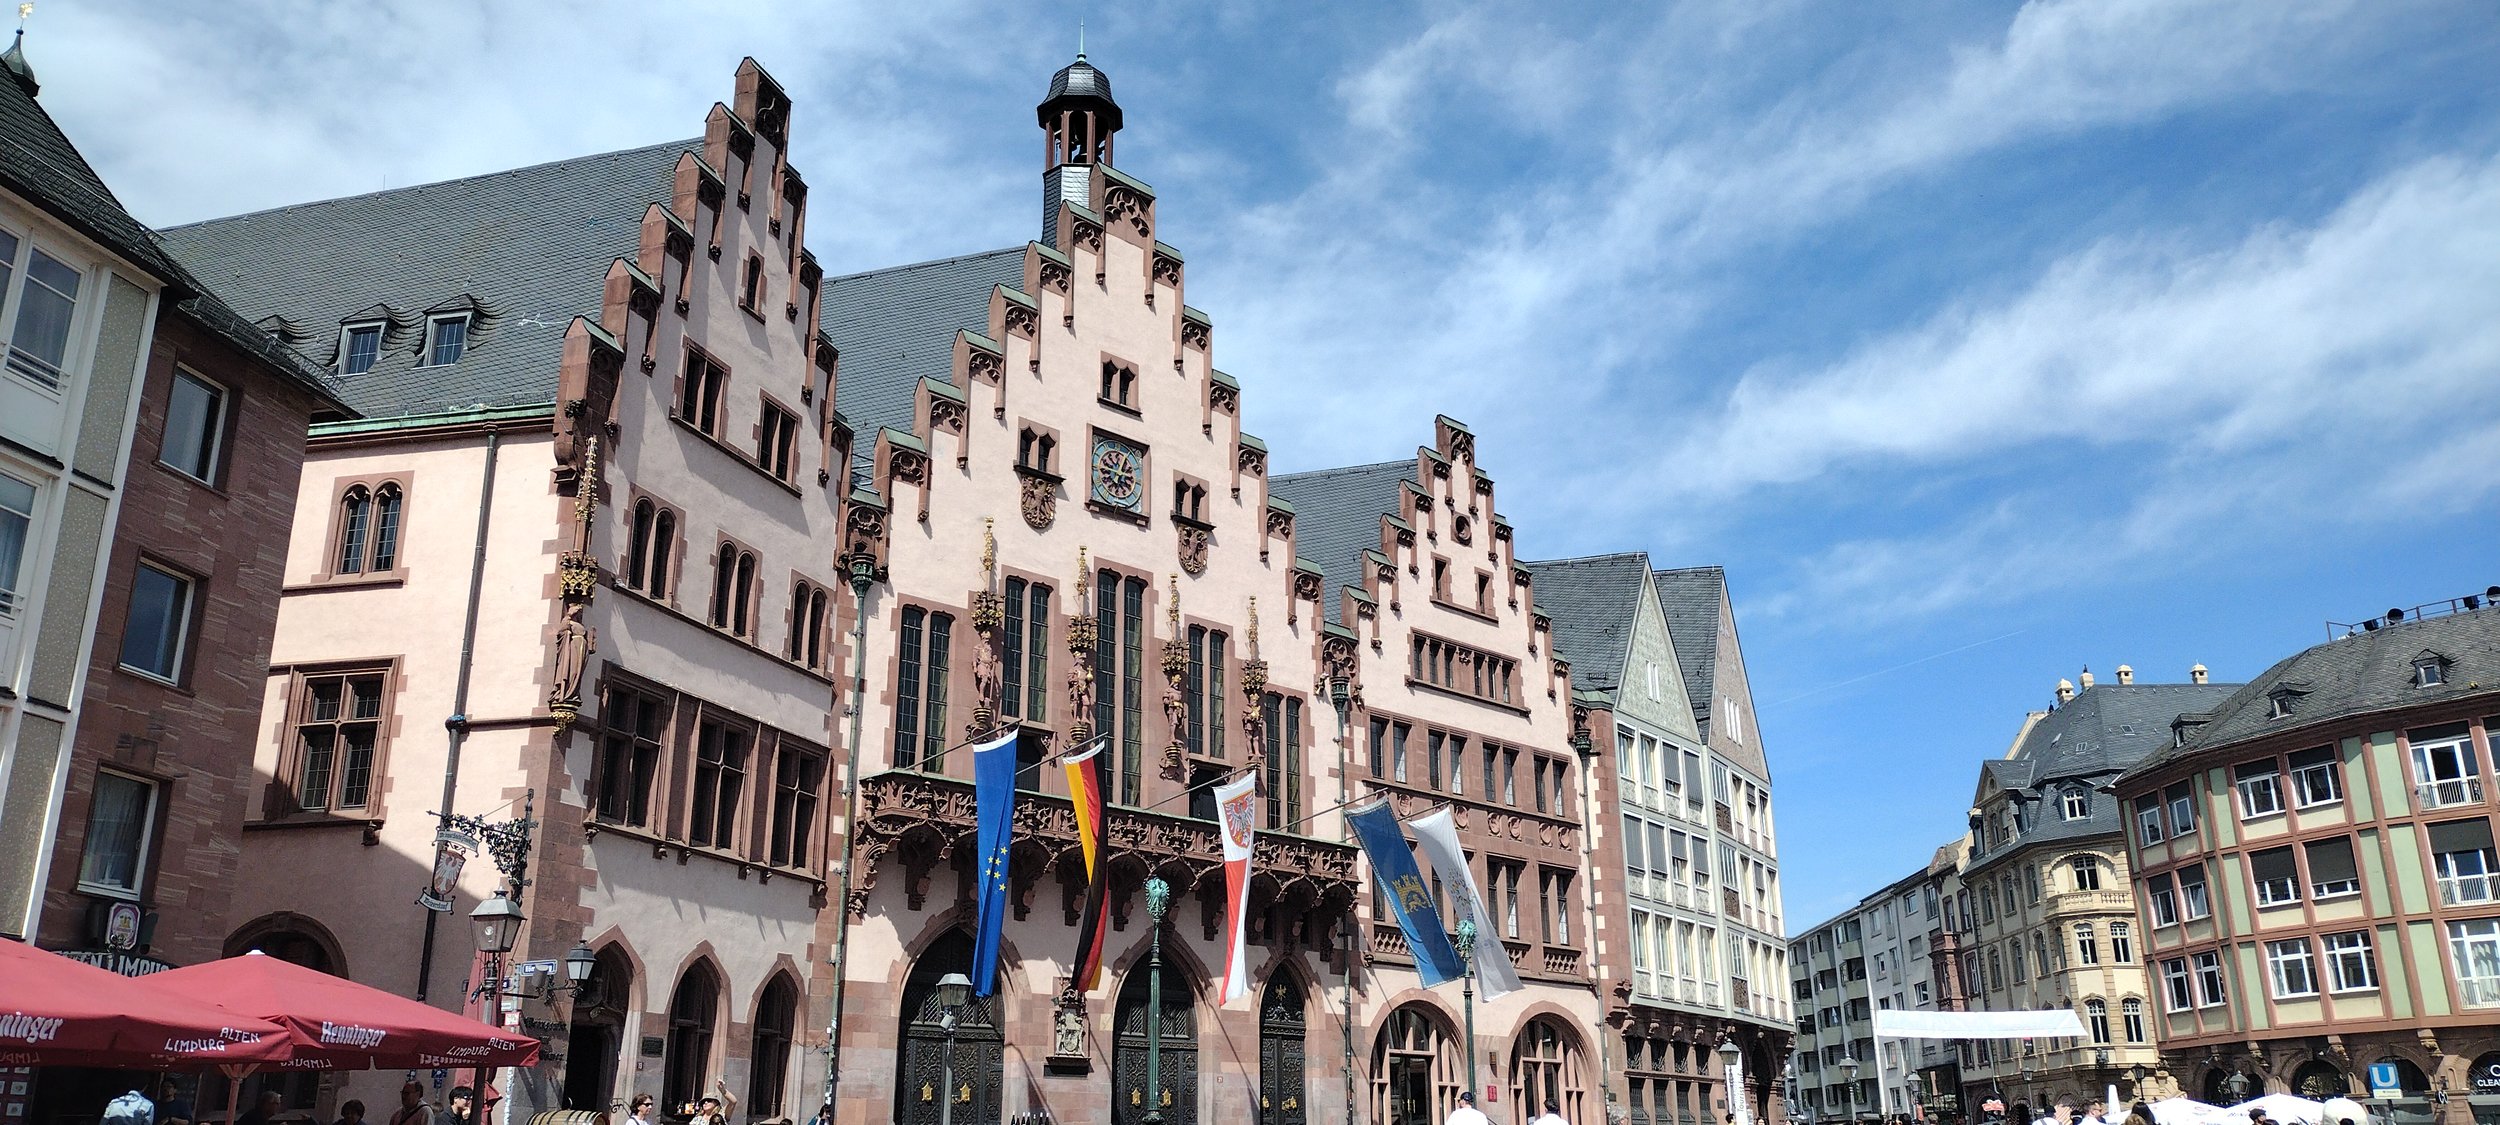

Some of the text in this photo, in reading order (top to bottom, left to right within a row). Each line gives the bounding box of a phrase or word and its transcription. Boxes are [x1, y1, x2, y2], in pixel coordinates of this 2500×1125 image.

[107, 955, 170, 977] LIMPU
[0, 1011, 64, 1043] ninger
[219, 1027, 260, 1043] ALTEN
[321, 1021, 386, 1049] Henninger
[164, 1038, 225, 1052] LIMPURG
[446, 1046, 491, 1057] LIMPURG
[488, 1037, 515, 1051] ALTEN
[2372, 1066, 2396, 1087] U
[2477, 1079, 2500, 1087] CLEA
